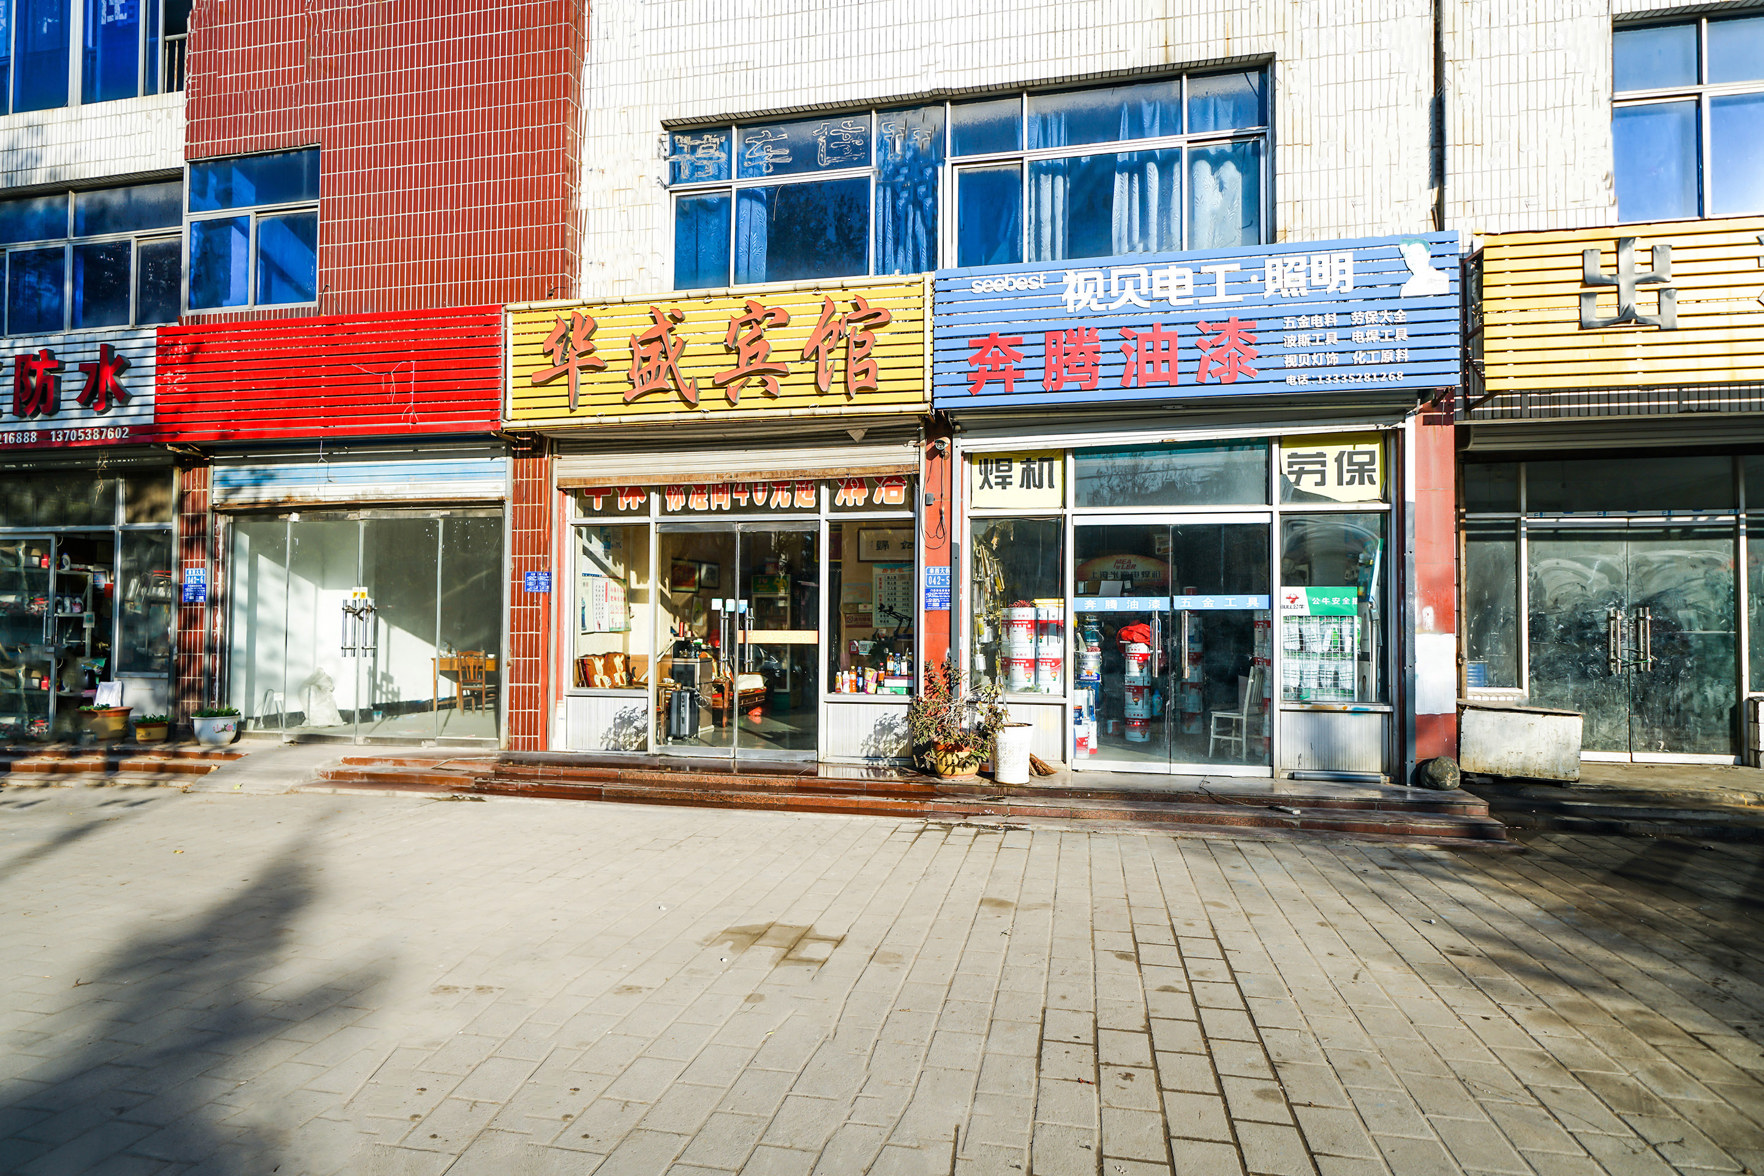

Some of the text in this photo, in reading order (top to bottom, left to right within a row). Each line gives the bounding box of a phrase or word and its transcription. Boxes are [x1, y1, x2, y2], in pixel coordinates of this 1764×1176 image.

[971, 273, 1047, 295] seebest
[1060, 252, 1356, 314] 视贝电工·照明
[1283, 309, 1408, 330] 五金电料 劳保大全
[1283, 328, 1409, 348] 波斯工具 电焊工具
[531, 295, 893, 412] 华盛宾馆
[967, 316, 1259, 396] 奔腾油漆
[1283, 348, 1410, 368] 视贝灯饰 化工原料
[0, 343, 131, 420] 防水
[0, 427, 129, 444] 16888 13705387602
[979, 457, 1054, 490] 焊机
[1286, 450, 1377, 487] 劳保
[928, 575, 950, 585] 042-5
[1084, 599, 1161, 610] 奔腾油漆
[1180, 597, 1260, 608] 五金工具
